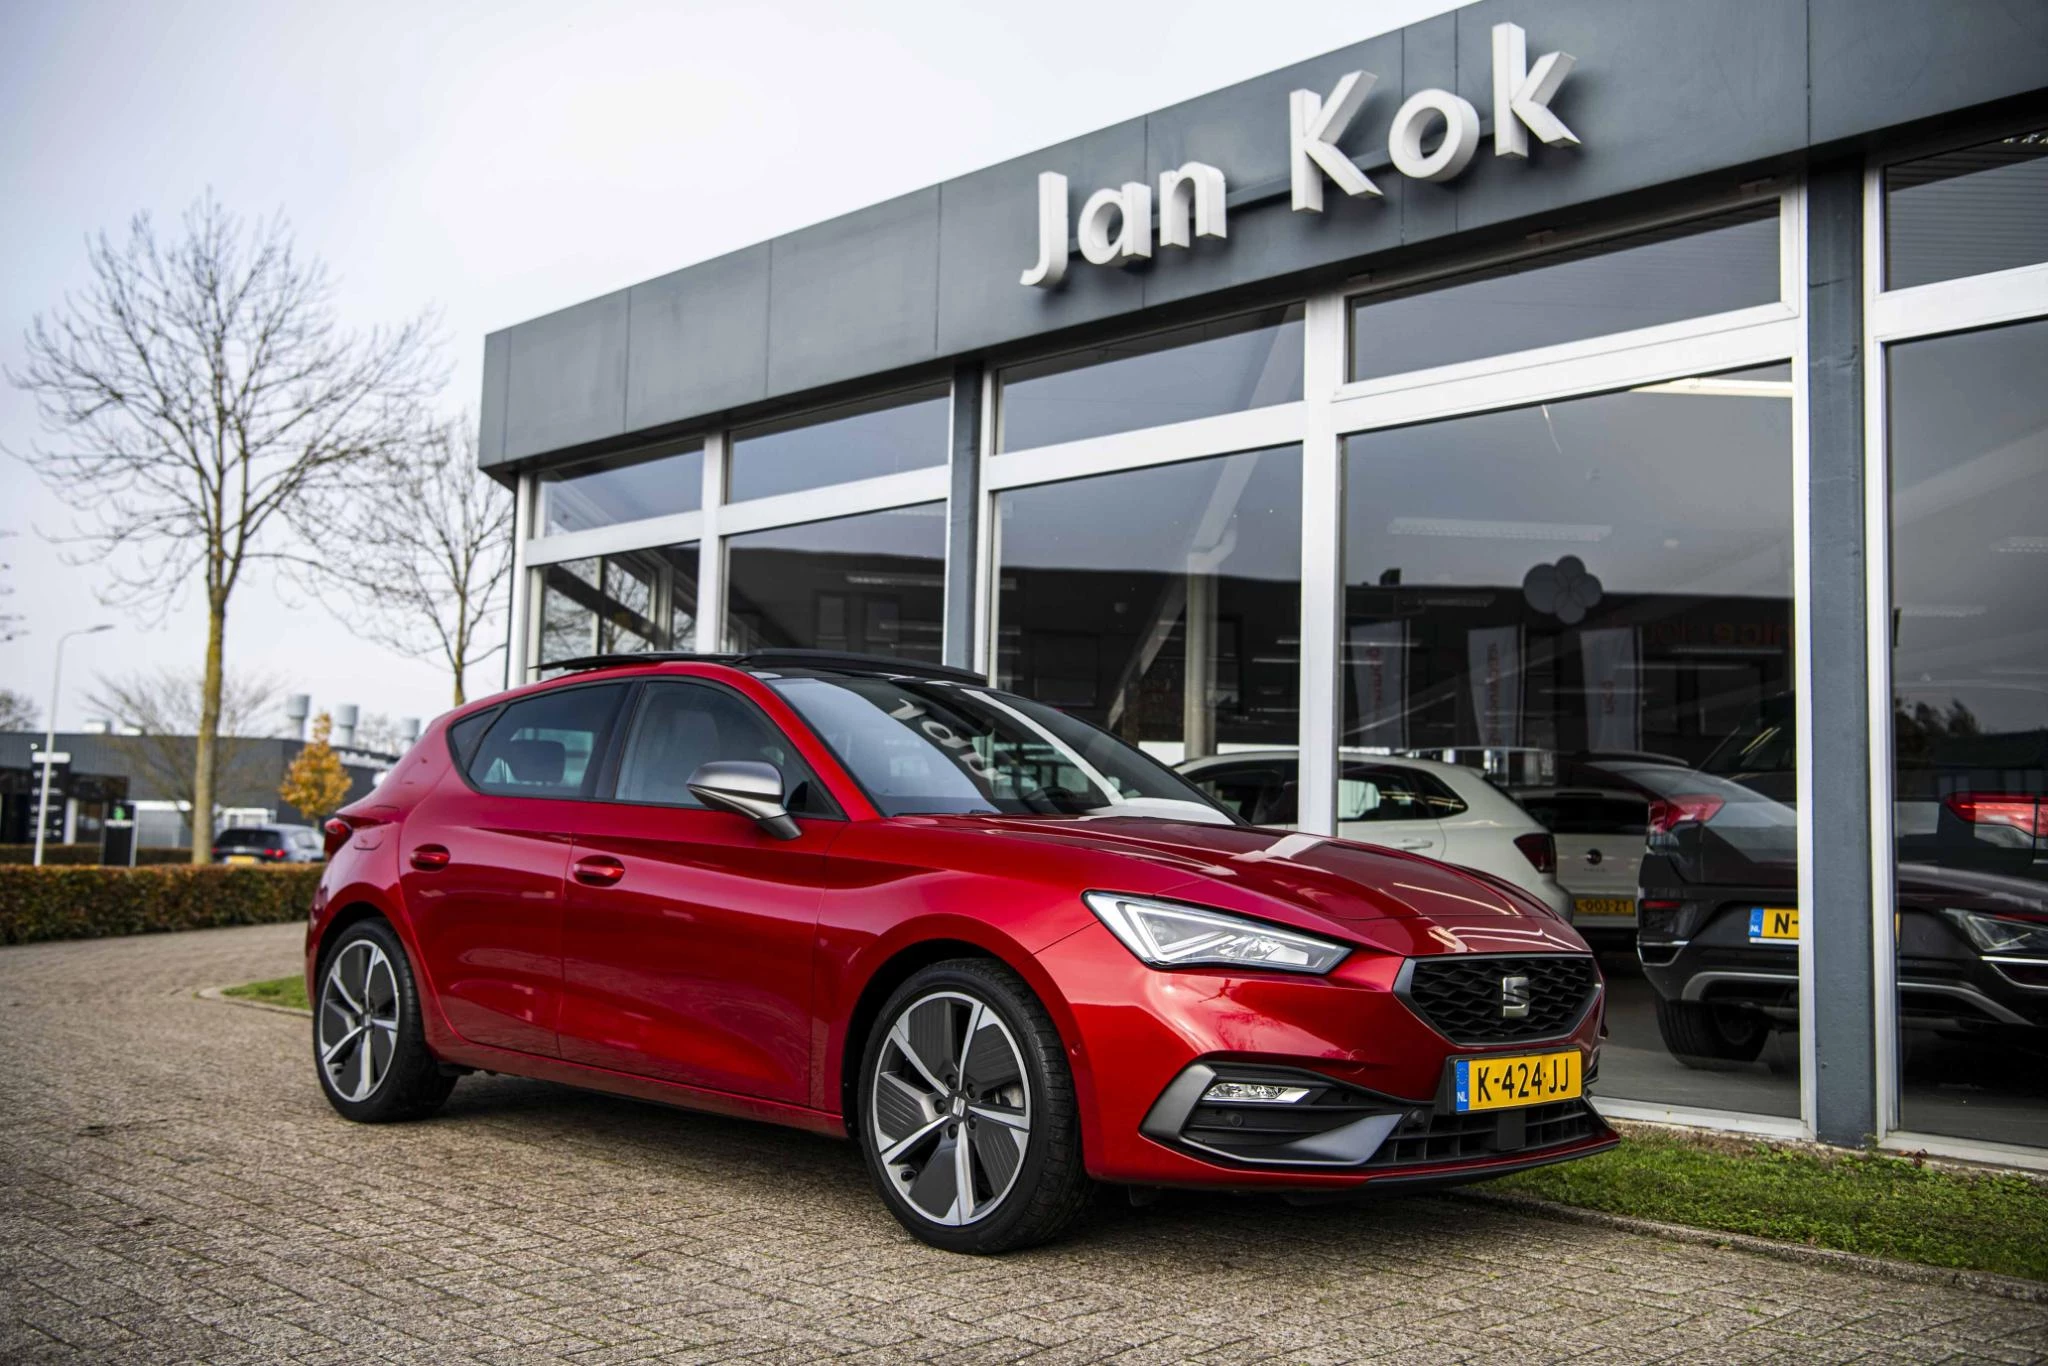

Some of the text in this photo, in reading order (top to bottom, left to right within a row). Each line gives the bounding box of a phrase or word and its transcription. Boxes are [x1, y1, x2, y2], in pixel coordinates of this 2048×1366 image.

[1020, 22, 1581, 288] Jan Kok
[1456, 1091, 1467, 1103] NL
[1477, 1058, 1569, 1102] K-424-JJ
